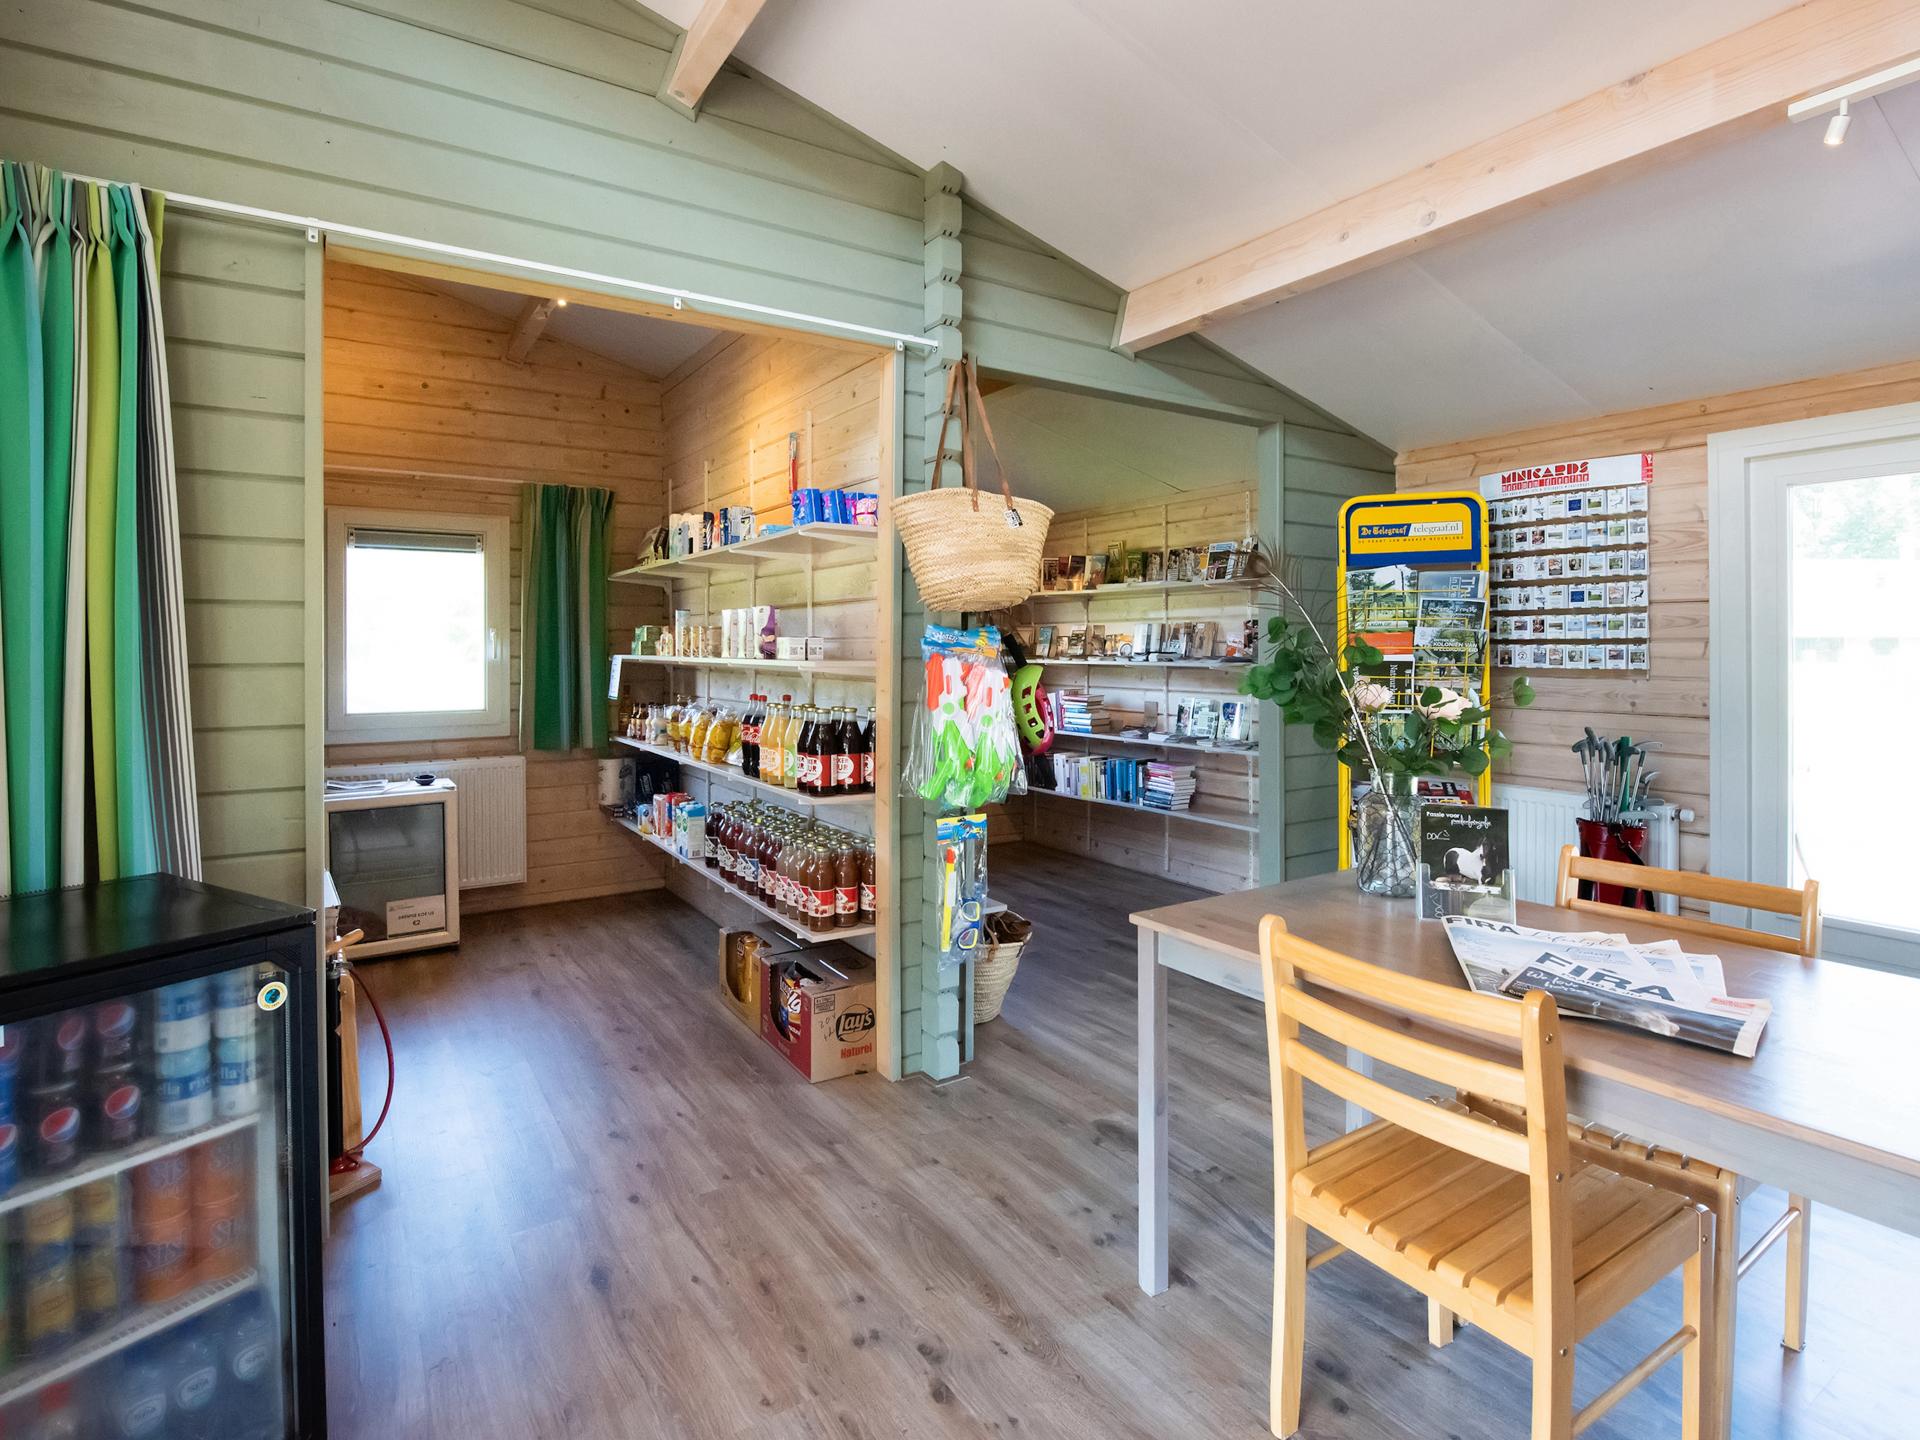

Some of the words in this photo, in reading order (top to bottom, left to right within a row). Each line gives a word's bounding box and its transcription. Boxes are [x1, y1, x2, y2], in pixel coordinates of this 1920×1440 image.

[1501, 461, 1589, 484] MINICARDS
[1372, 525, 1408, 536] Telegraaf
[1413, 522, 1459, 535] telegraaf.nl
[1446, 916, 1521, 935] FIRA
[1535, 952, 1675, 1002] FIRA
[839, 1009, 873, 1036] Lay's
